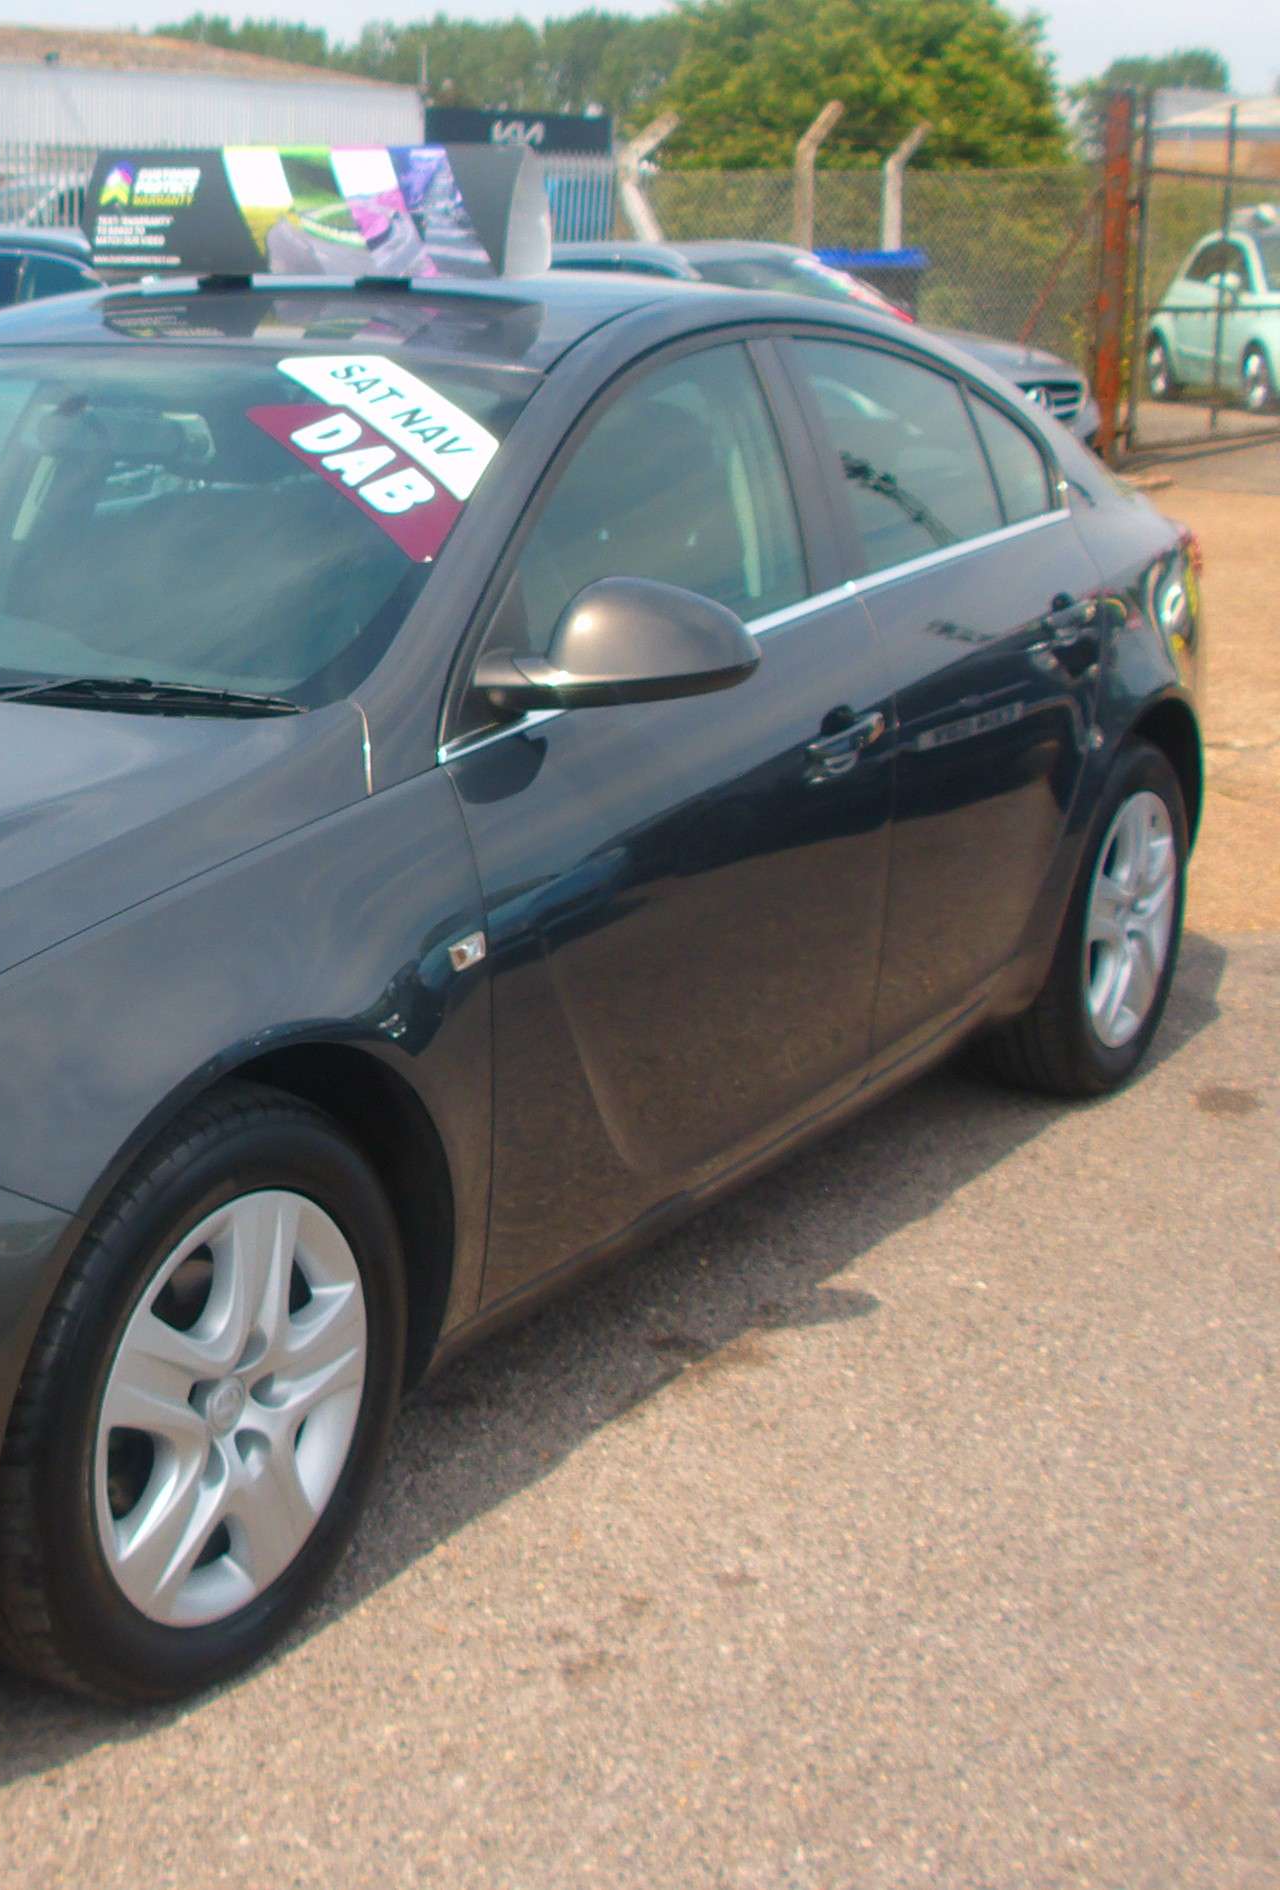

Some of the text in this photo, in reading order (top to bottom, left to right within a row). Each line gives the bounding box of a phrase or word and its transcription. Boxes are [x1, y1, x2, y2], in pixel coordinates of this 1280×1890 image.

[329, 362, 475, 456] SAT NAV
[289, 411, 437, 515] DAB
